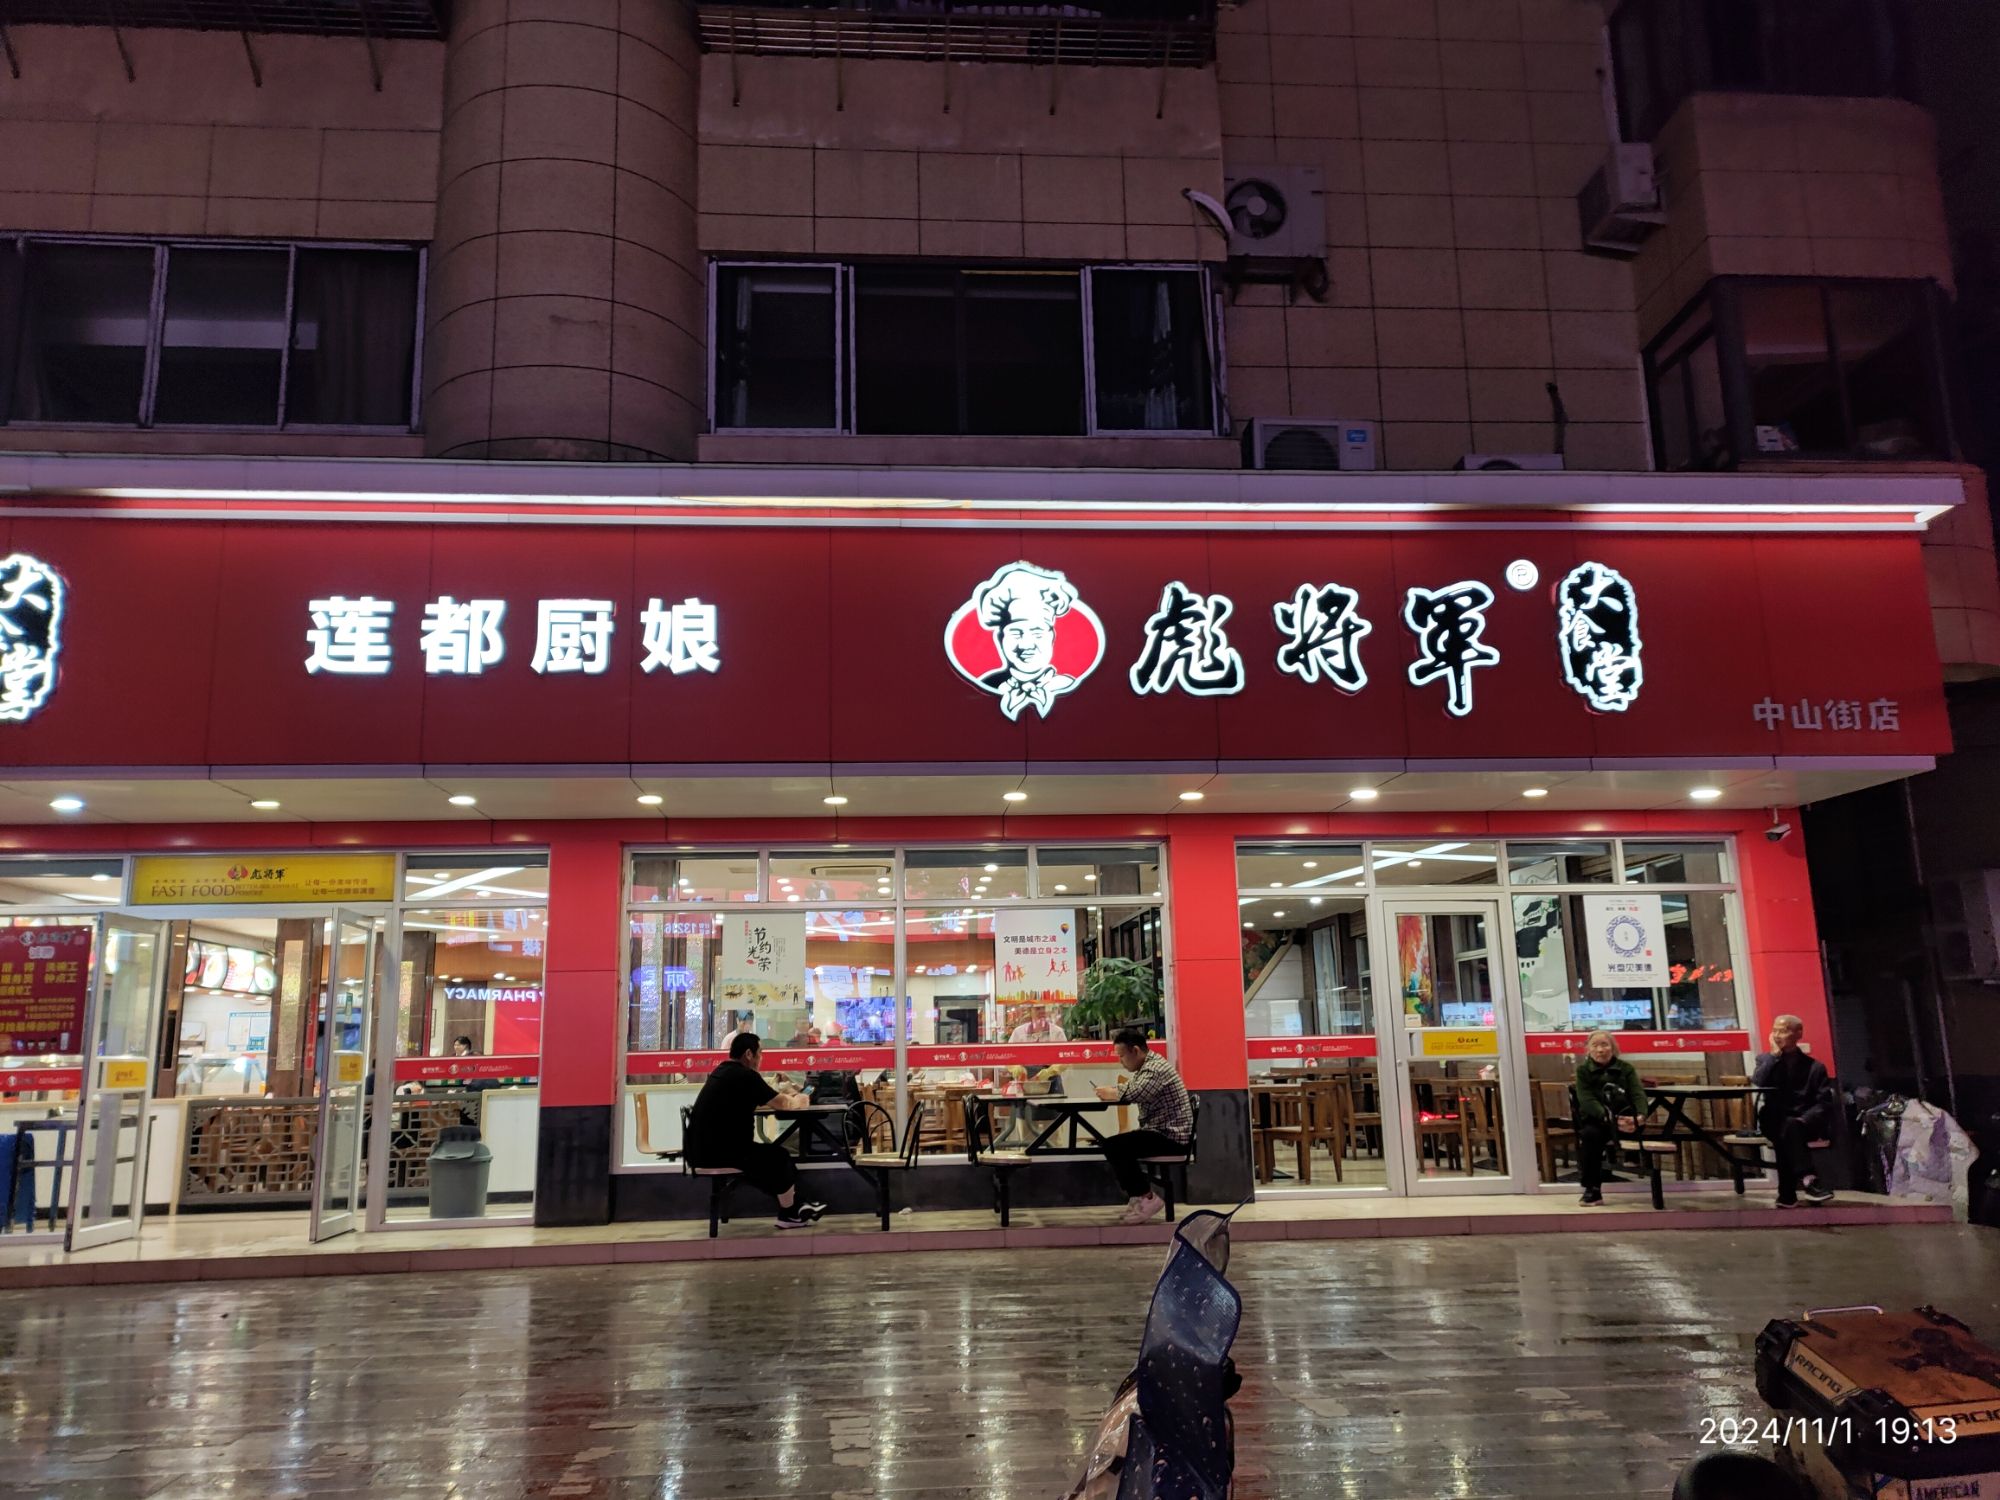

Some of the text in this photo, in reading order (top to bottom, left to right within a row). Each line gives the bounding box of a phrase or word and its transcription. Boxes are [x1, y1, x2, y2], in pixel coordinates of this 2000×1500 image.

[304, 596, 721, 674] 莲都厨娘
[1561, 563, 1642, 709] 大食堂
[1753, 697, 1900, 731] 中山街店
[151, 885, 185, 897] FAST
[191, 884, 235, 897] FOOD
[746, 927, 772, 972] 节约光荣
[1003, 935, 1057, 944] 文明是城市之魂
[1014, 947, 1068, 955] 美德是立身之本
[1795, 1354, 1843, 1394] RACING
